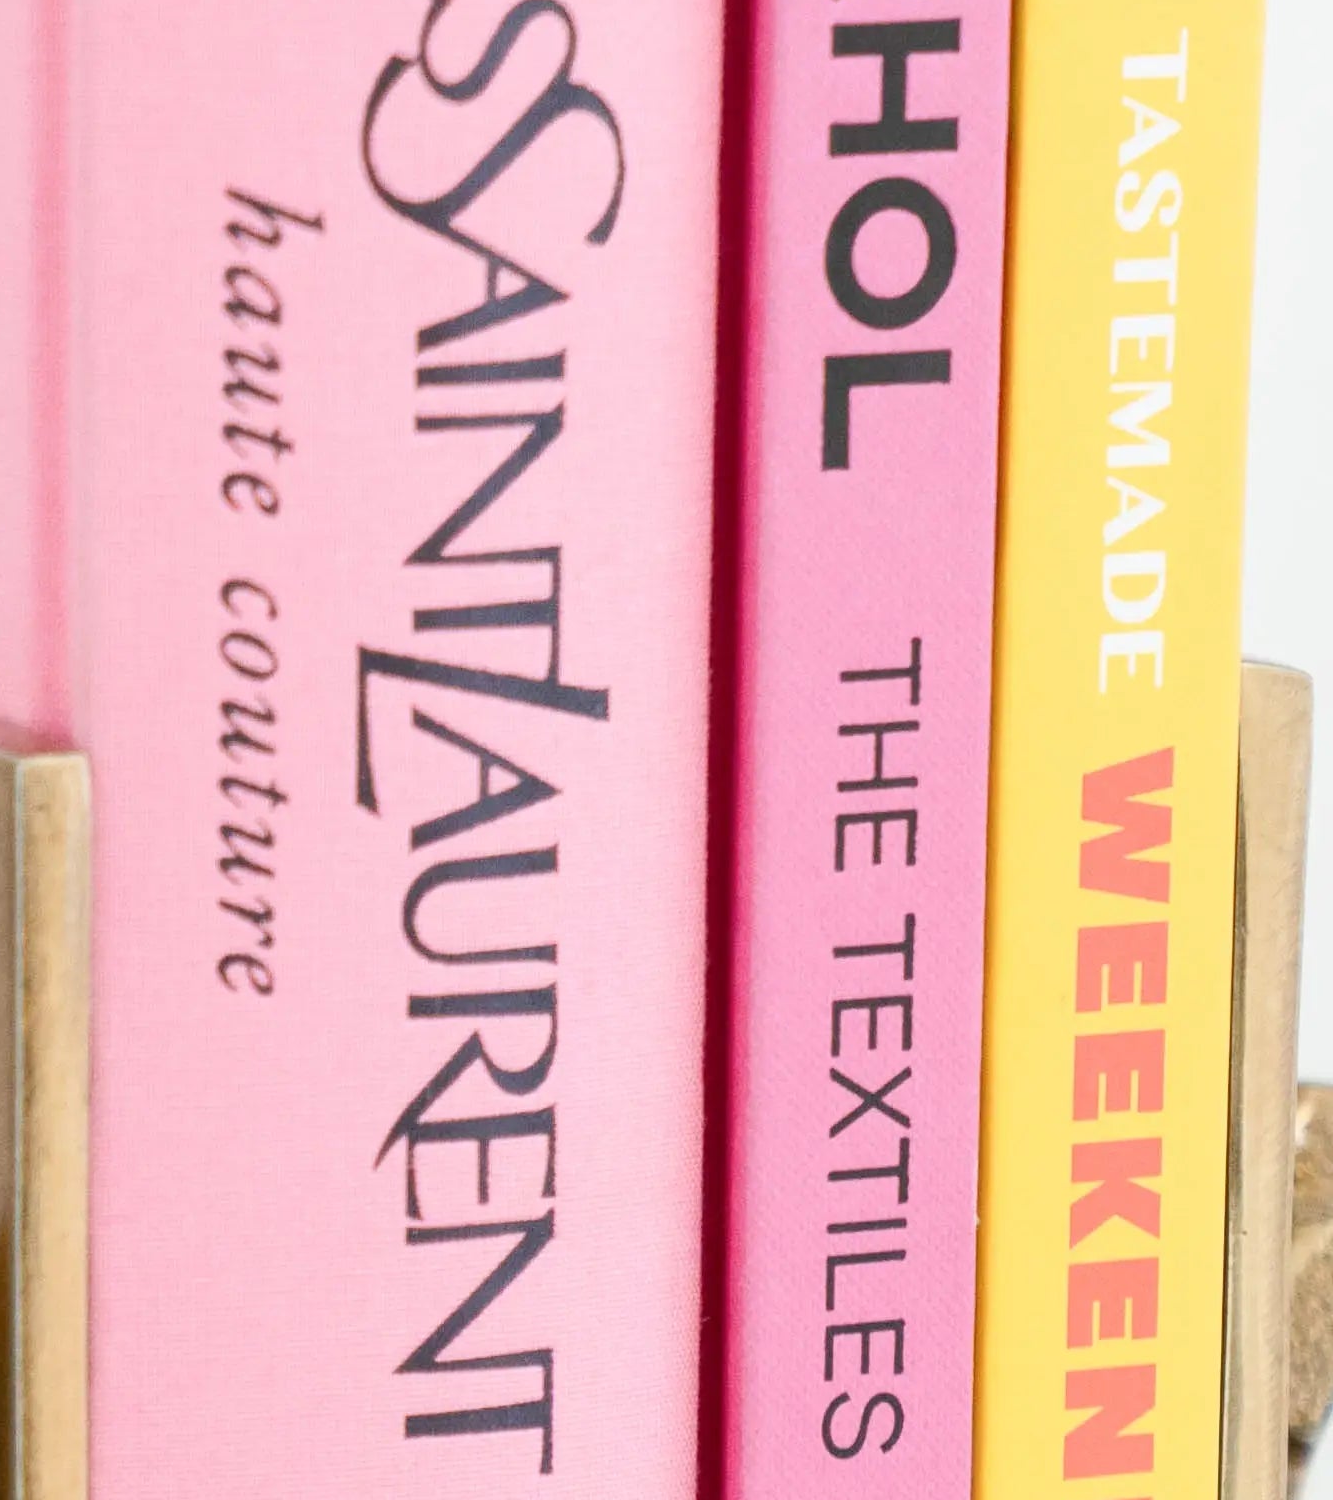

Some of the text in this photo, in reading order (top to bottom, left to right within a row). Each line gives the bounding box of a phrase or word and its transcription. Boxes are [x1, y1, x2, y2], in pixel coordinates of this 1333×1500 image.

[217, 188, 324, 995] haute couture
[1099, 28, 1188, 693] TASTEMADE
[822, 637, 922, 1459] THE TEXTILES
